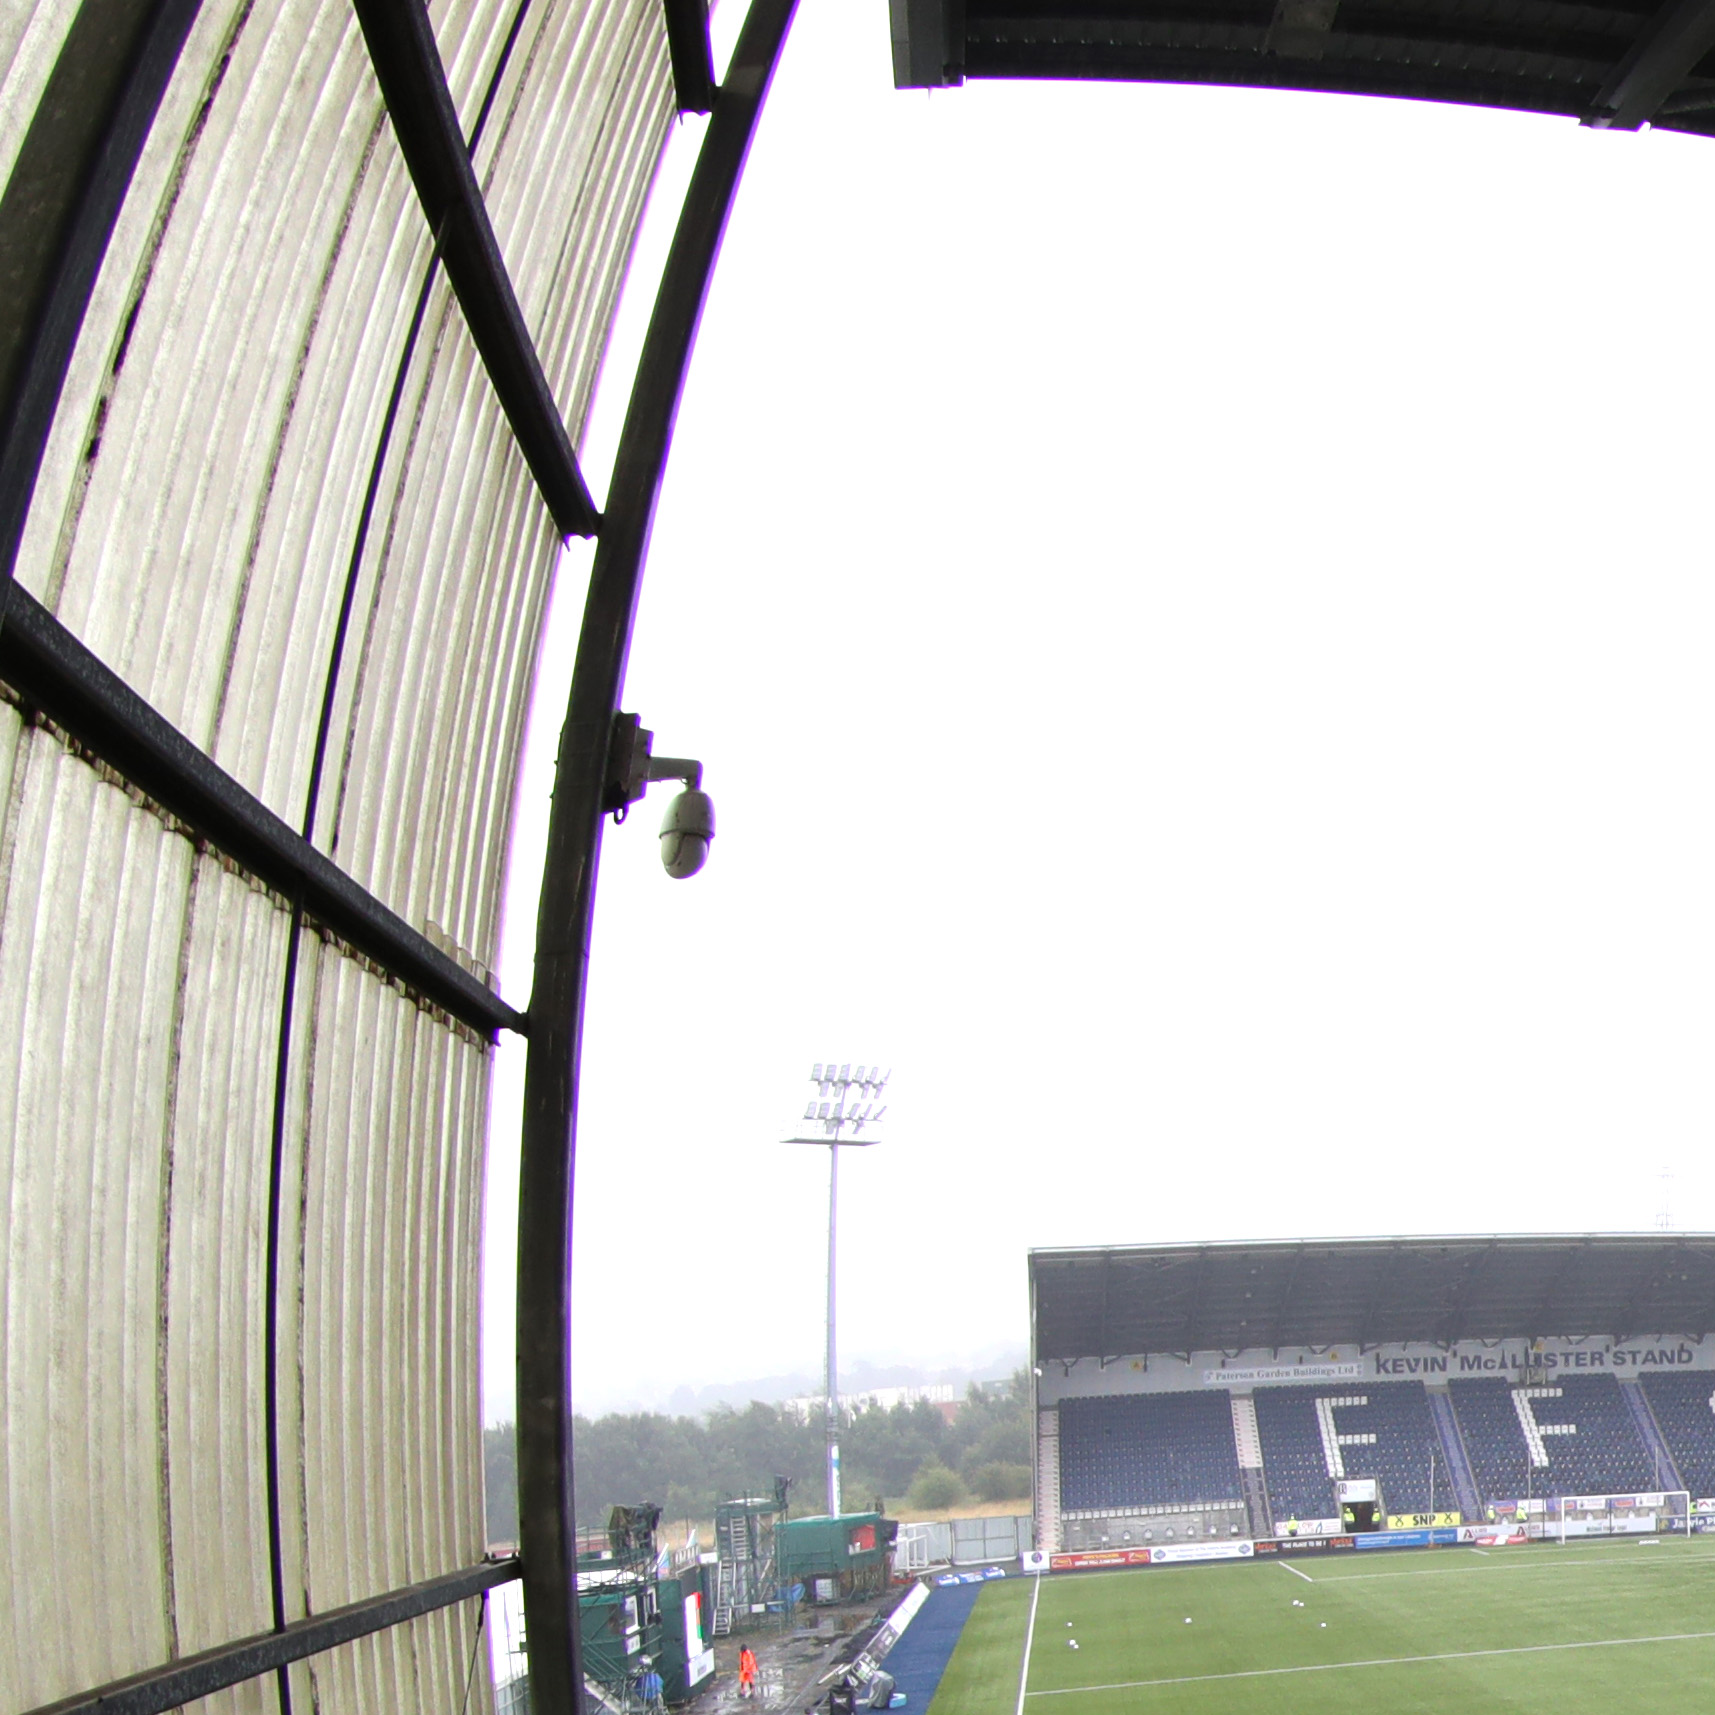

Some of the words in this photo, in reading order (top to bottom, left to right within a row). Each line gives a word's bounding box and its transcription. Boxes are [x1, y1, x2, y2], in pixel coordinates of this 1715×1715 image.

[1375, 1353, 1448, 1375] KEVIN
[1612, 1348, 1695, 1366] STAND
[1257, 1369, 1291, 1379] Garden
[1293, 1366, 1335, 1379] Buildings
[1338, 1365, 1354, 1375] Ltd
[1412, 1514, 1436, 1526] SNP
[1672, 1517, 1705, 1529] Javie
